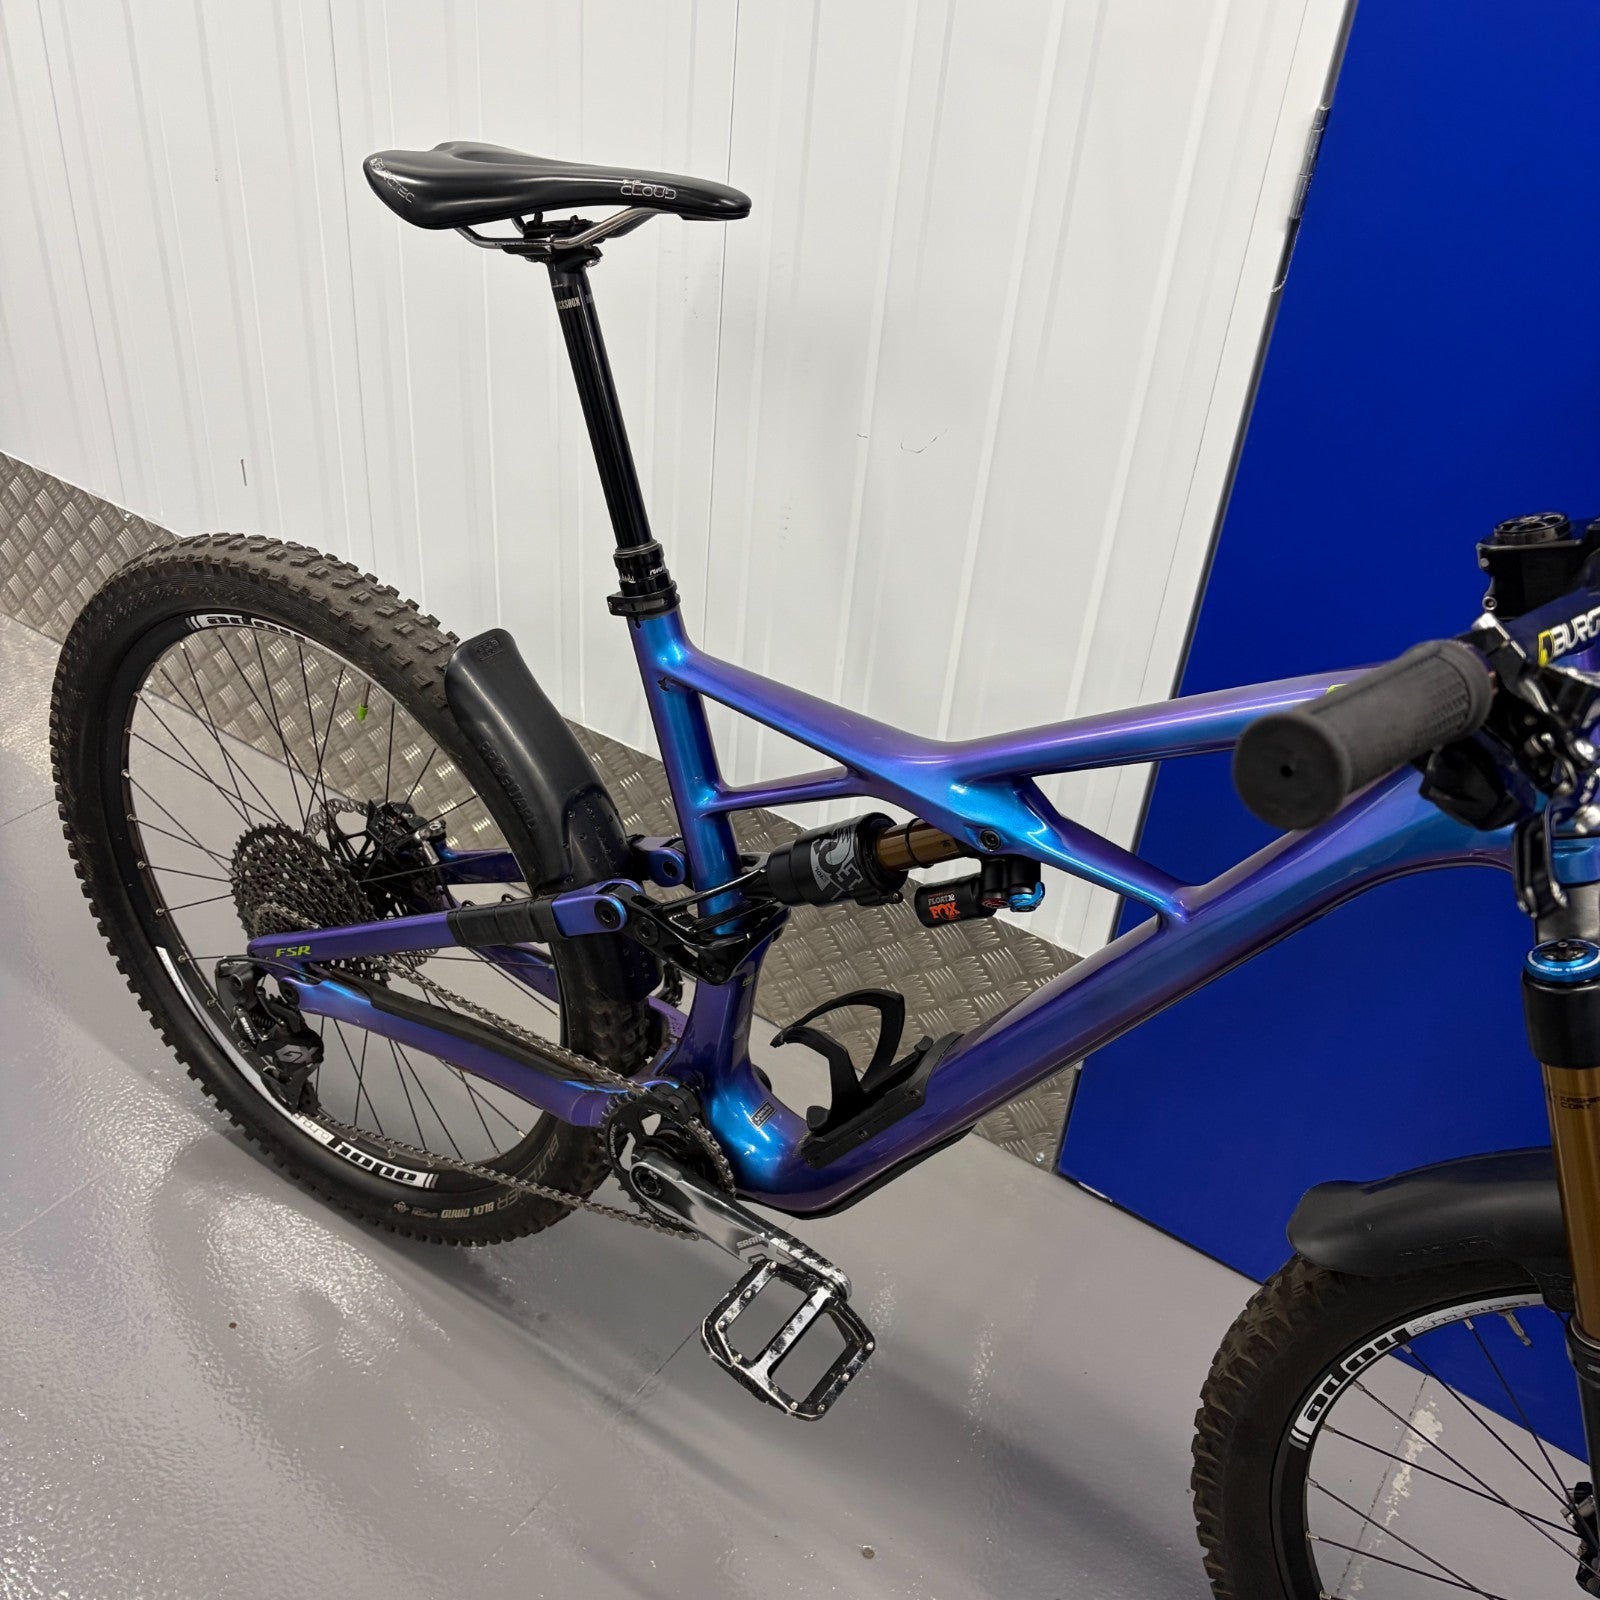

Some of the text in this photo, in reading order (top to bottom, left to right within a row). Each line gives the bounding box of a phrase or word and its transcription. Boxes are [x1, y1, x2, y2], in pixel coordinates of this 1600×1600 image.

[620, 185, 677, 200] CLOUD
[929, 902, 961, 920] FOX
[275, 945, 311, 958] FSR
[440, 1208, 471, 1220] DMND
[472, 1201, 495, 1216] BLCK
